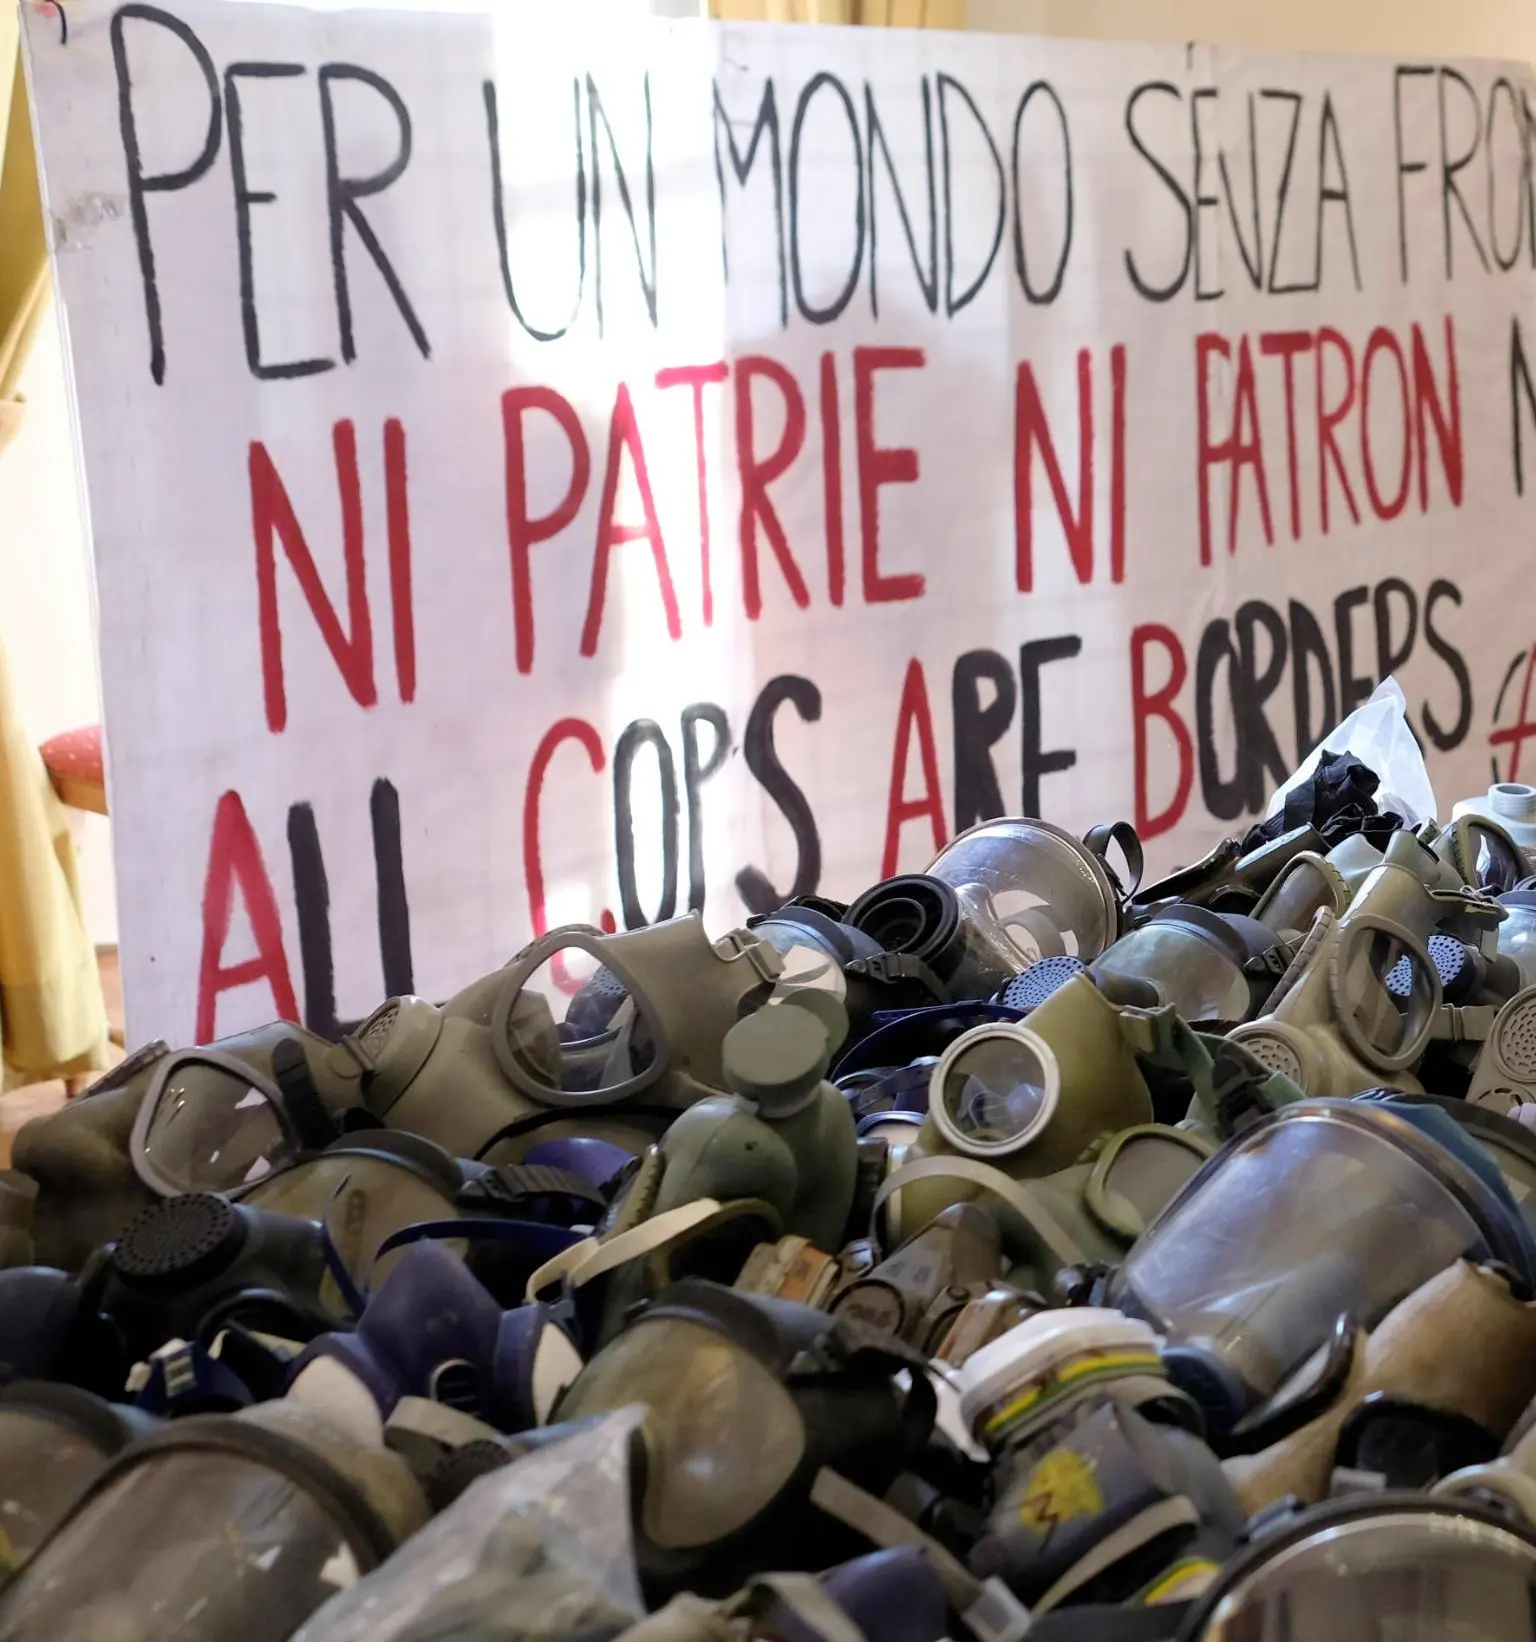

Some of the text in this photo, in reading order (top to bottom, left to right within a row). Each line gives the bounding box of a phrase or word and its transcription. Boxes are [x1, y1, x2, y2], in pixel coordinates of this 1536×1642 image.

[110, 4, 432, 386] PER
[483, 70, 658, 342] UN
[711, 71, 1074, 328] MONDO
[1124, 80, 1361, 302] SENZA
[249, 416, 416, 733] NI
[501, 345, 926, 675] PATRIE
[1014, 342, 1126, 594] NI
[1195, 314, 1464, 568] PATRON
[523, 674, 823, 994] COPS
[880, 633, 1083, 882] ARE
[1130, 576, 1474, 840] BORDERS
